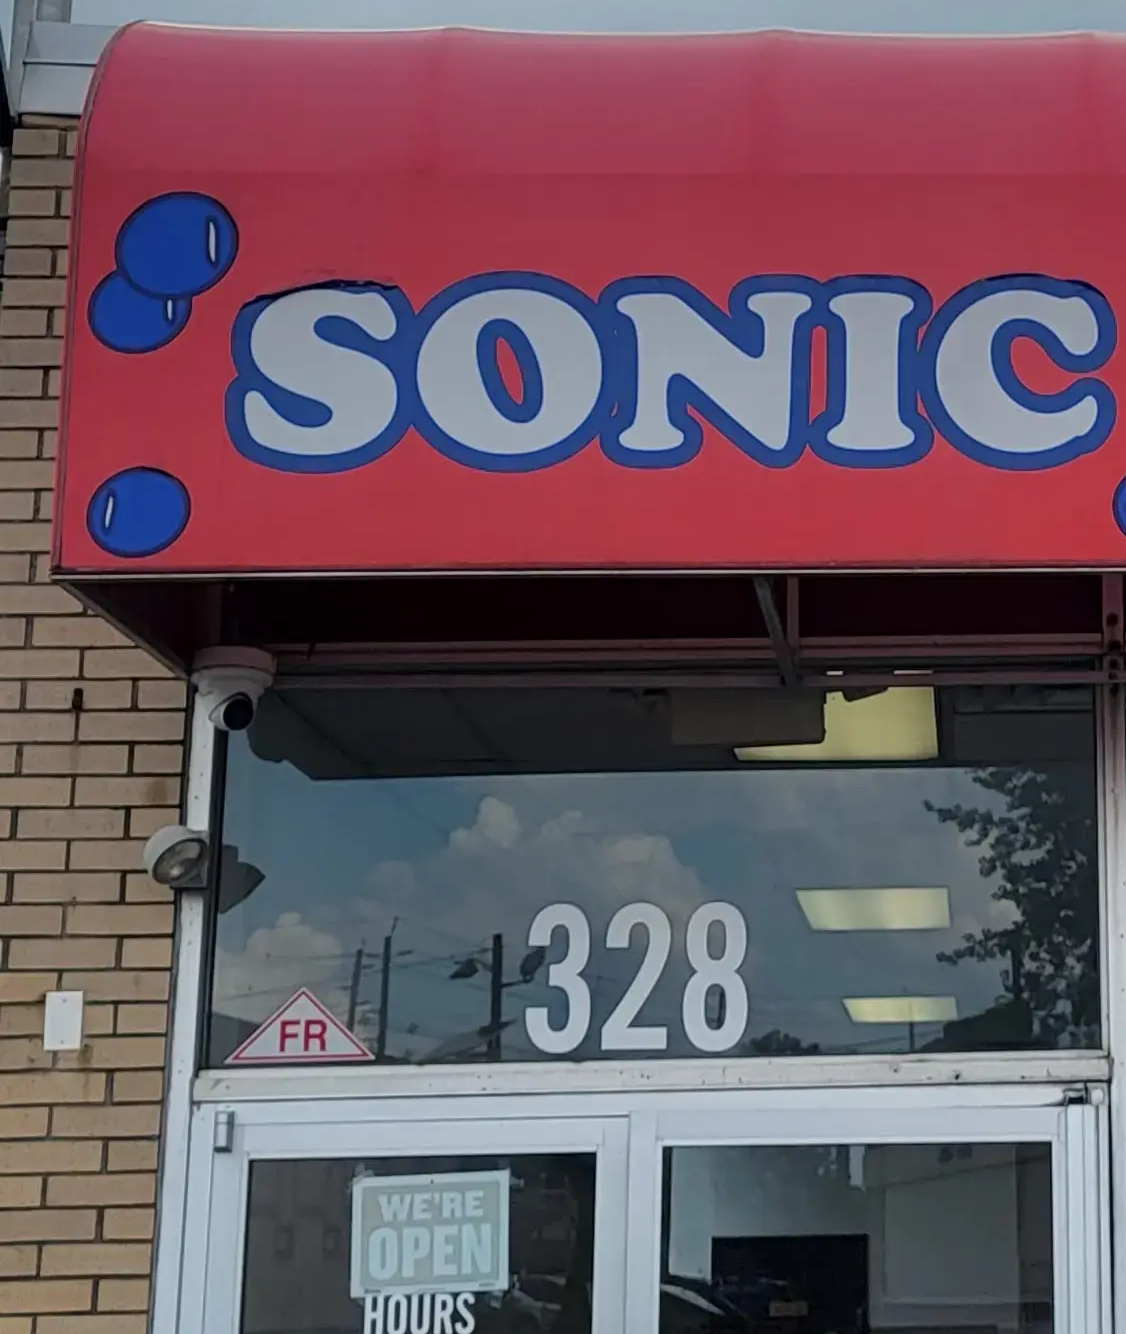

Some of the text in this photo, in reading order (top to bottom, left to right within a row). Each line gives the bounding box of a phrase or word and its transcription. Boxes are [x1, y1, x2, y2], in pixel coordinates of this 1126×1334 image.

[227, 273, 1116, 472] SONIC
[525, 901, 748, 1054] 328
[279, 1018, 327, 1053] FR
[378, 1190, 484, 1222] WE'RE
[368, 1223, 492, 1280] OPEN
